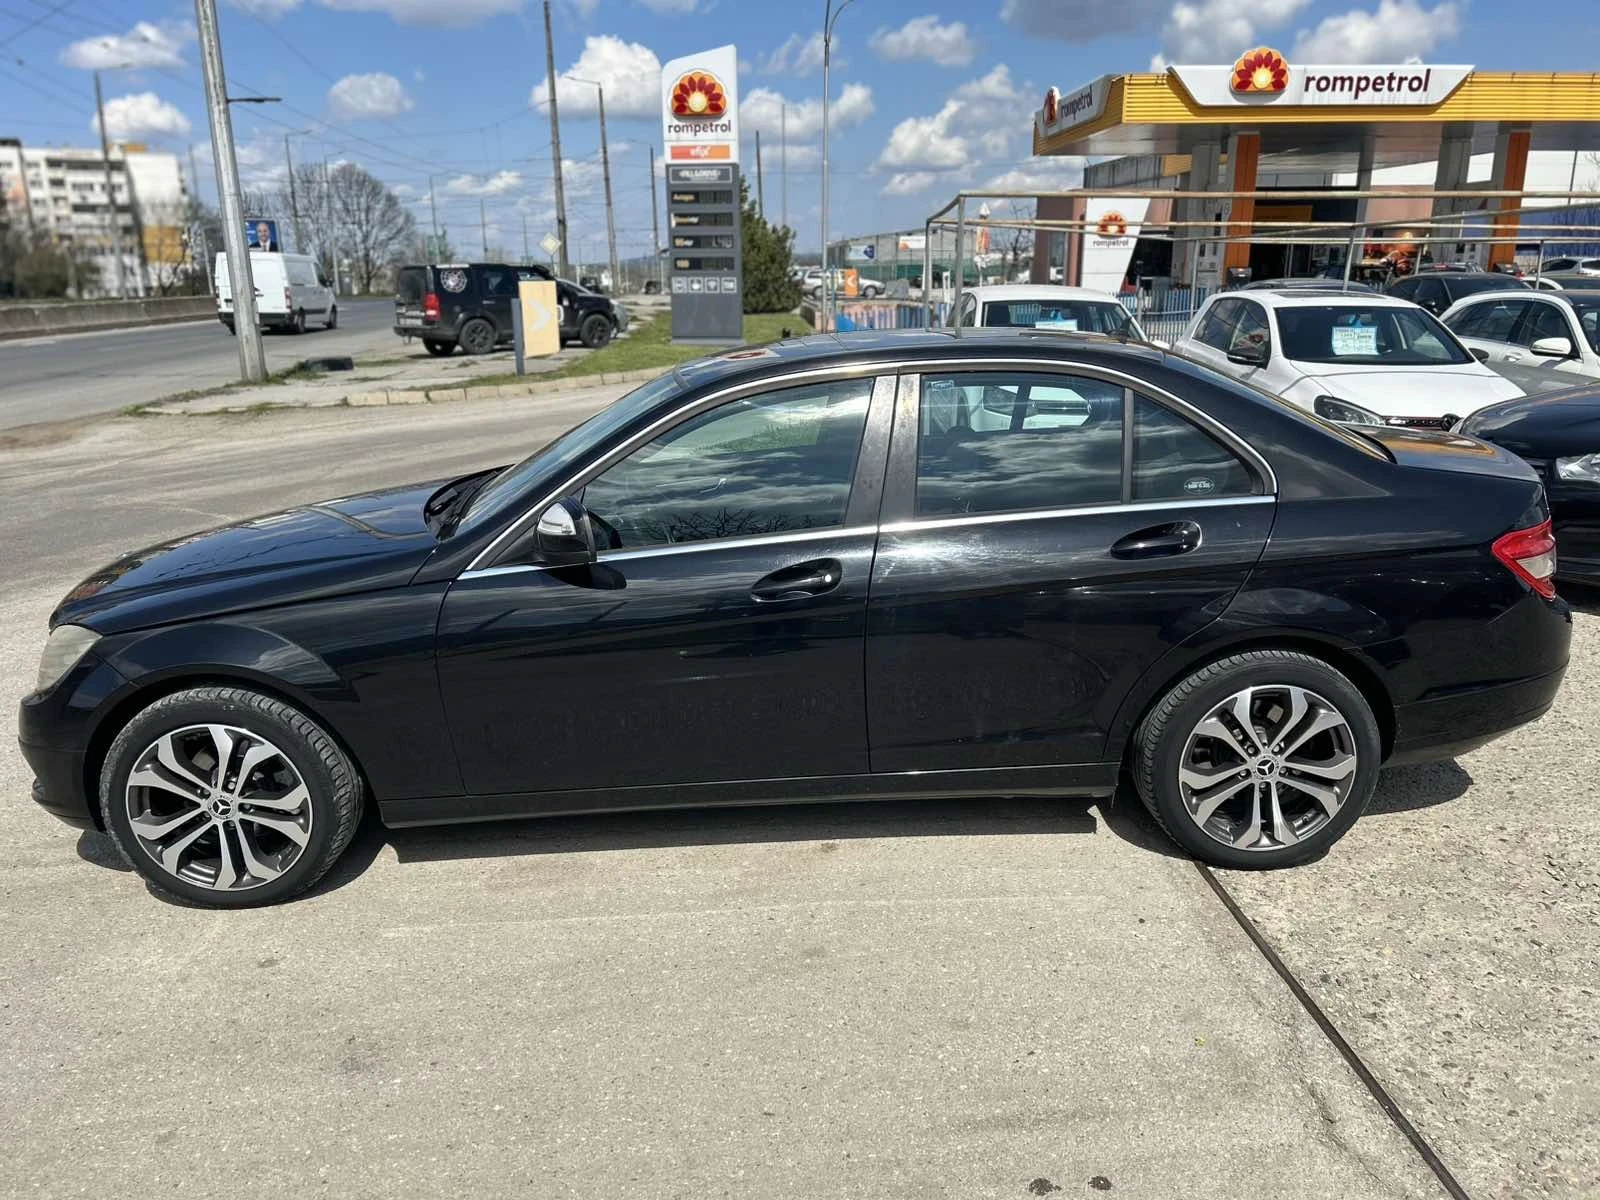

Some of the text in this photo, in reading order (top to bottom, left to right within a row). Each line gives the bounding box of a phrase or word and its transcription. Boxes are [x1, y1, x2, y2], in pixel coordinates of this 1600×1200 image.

[1304, 68, 1432, 100] rompetrol
[1061, 84, 1093, 121] rompetrol
[668, 119, 732, 137] rompetrol
[1092, 238, 1129, 248] rompetrol
